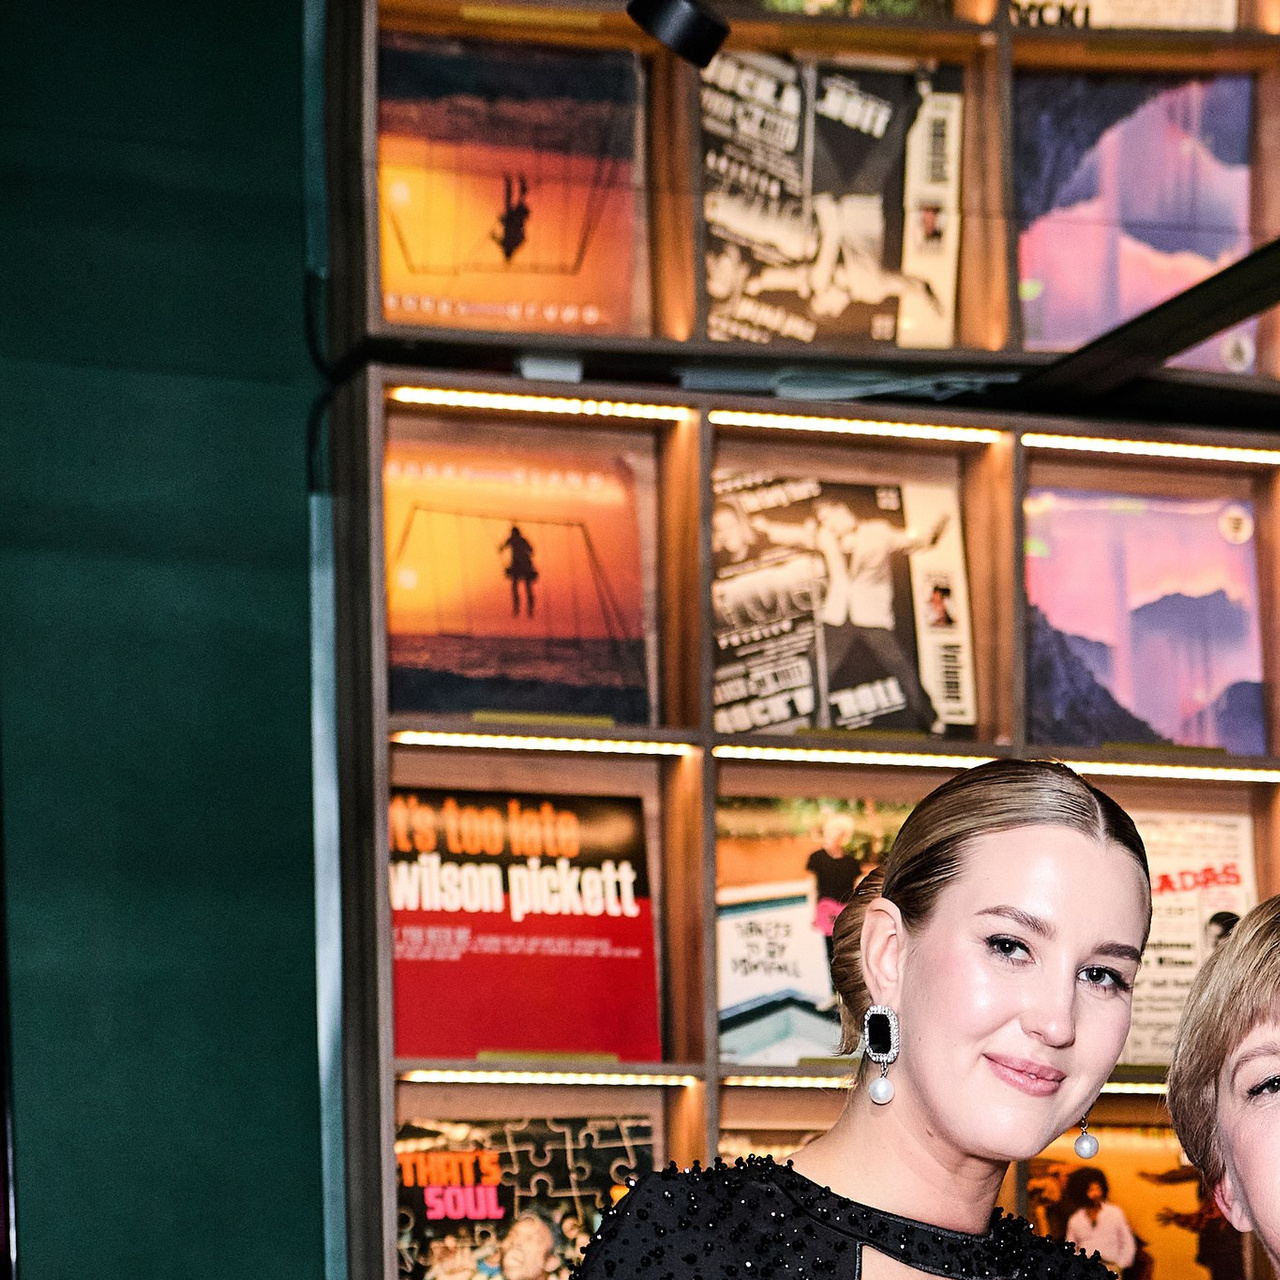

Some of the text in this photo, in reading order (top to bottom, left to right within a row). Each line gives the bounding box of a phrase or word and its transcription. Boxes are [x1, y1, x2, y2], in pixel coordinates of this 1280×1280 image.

[389, 795, 580, 858] t's too late
[389, 851, 640, 923] wilson pickett
[397, 1150, 501, 1187] THAT'S
[424, 1185, 506, 1220] SOUL
